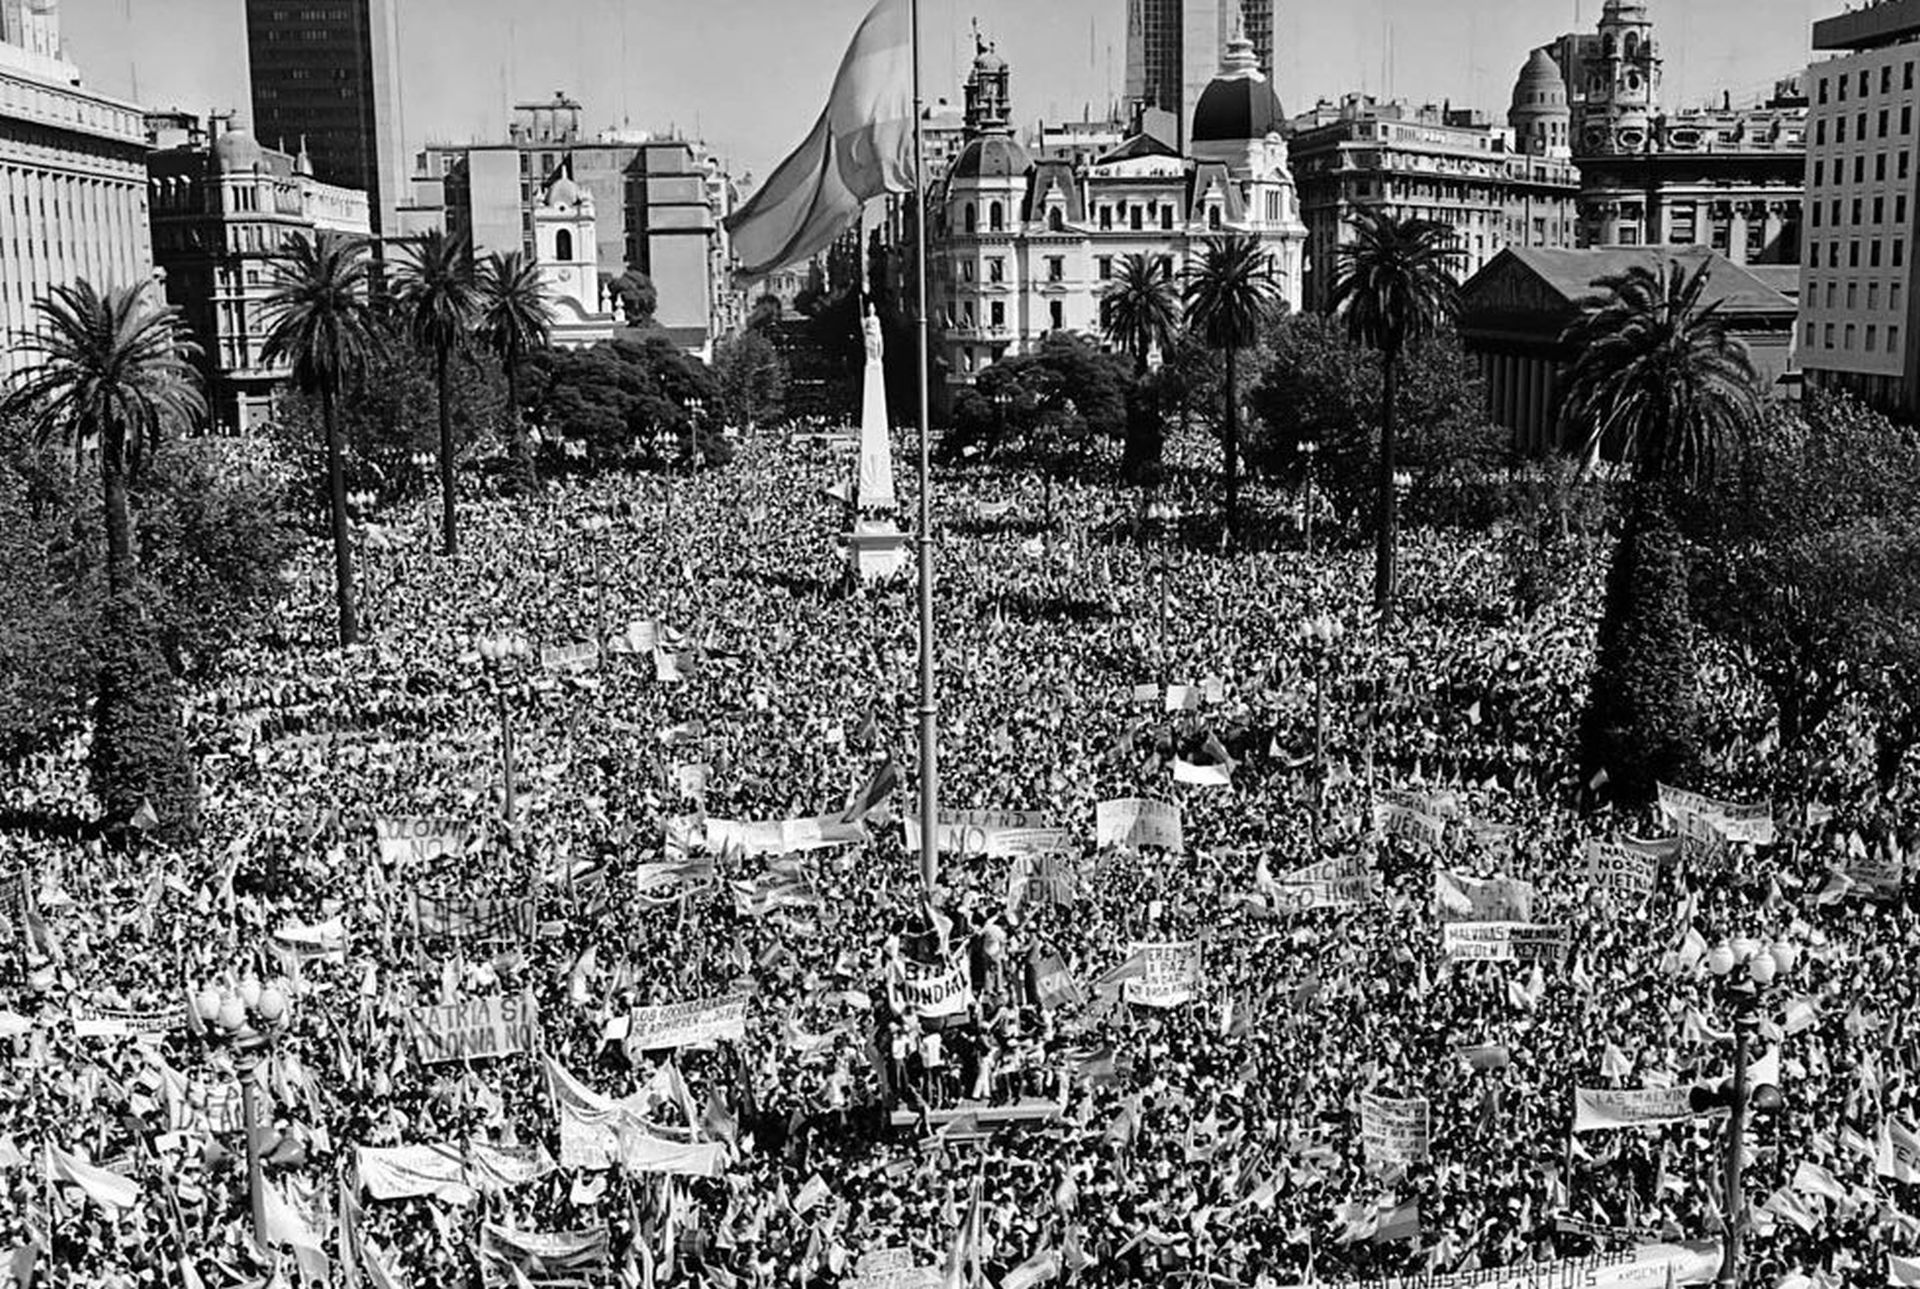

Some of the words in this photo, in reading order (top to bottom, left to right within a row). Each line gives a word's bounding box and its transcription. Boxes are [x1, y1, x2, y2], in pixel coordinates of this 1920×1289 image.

[411, 838, 443, 862] NO
[949, 825, 986, 860] NO
[1295, 856, 1368, 881] ATCHER
[1449, 926, 1505, 942] MALVINAS
[412, 1000, 490, 1031] PATRIA
[500, 998, 527, 1022] SI
[415, 1026, 497, 1060] OLONIA
[505, 1024, 532, 1052] NO
[1597, 1092, 1626, 1106] LAS
[1633, 1087, 1687, 1103] MALVIN
